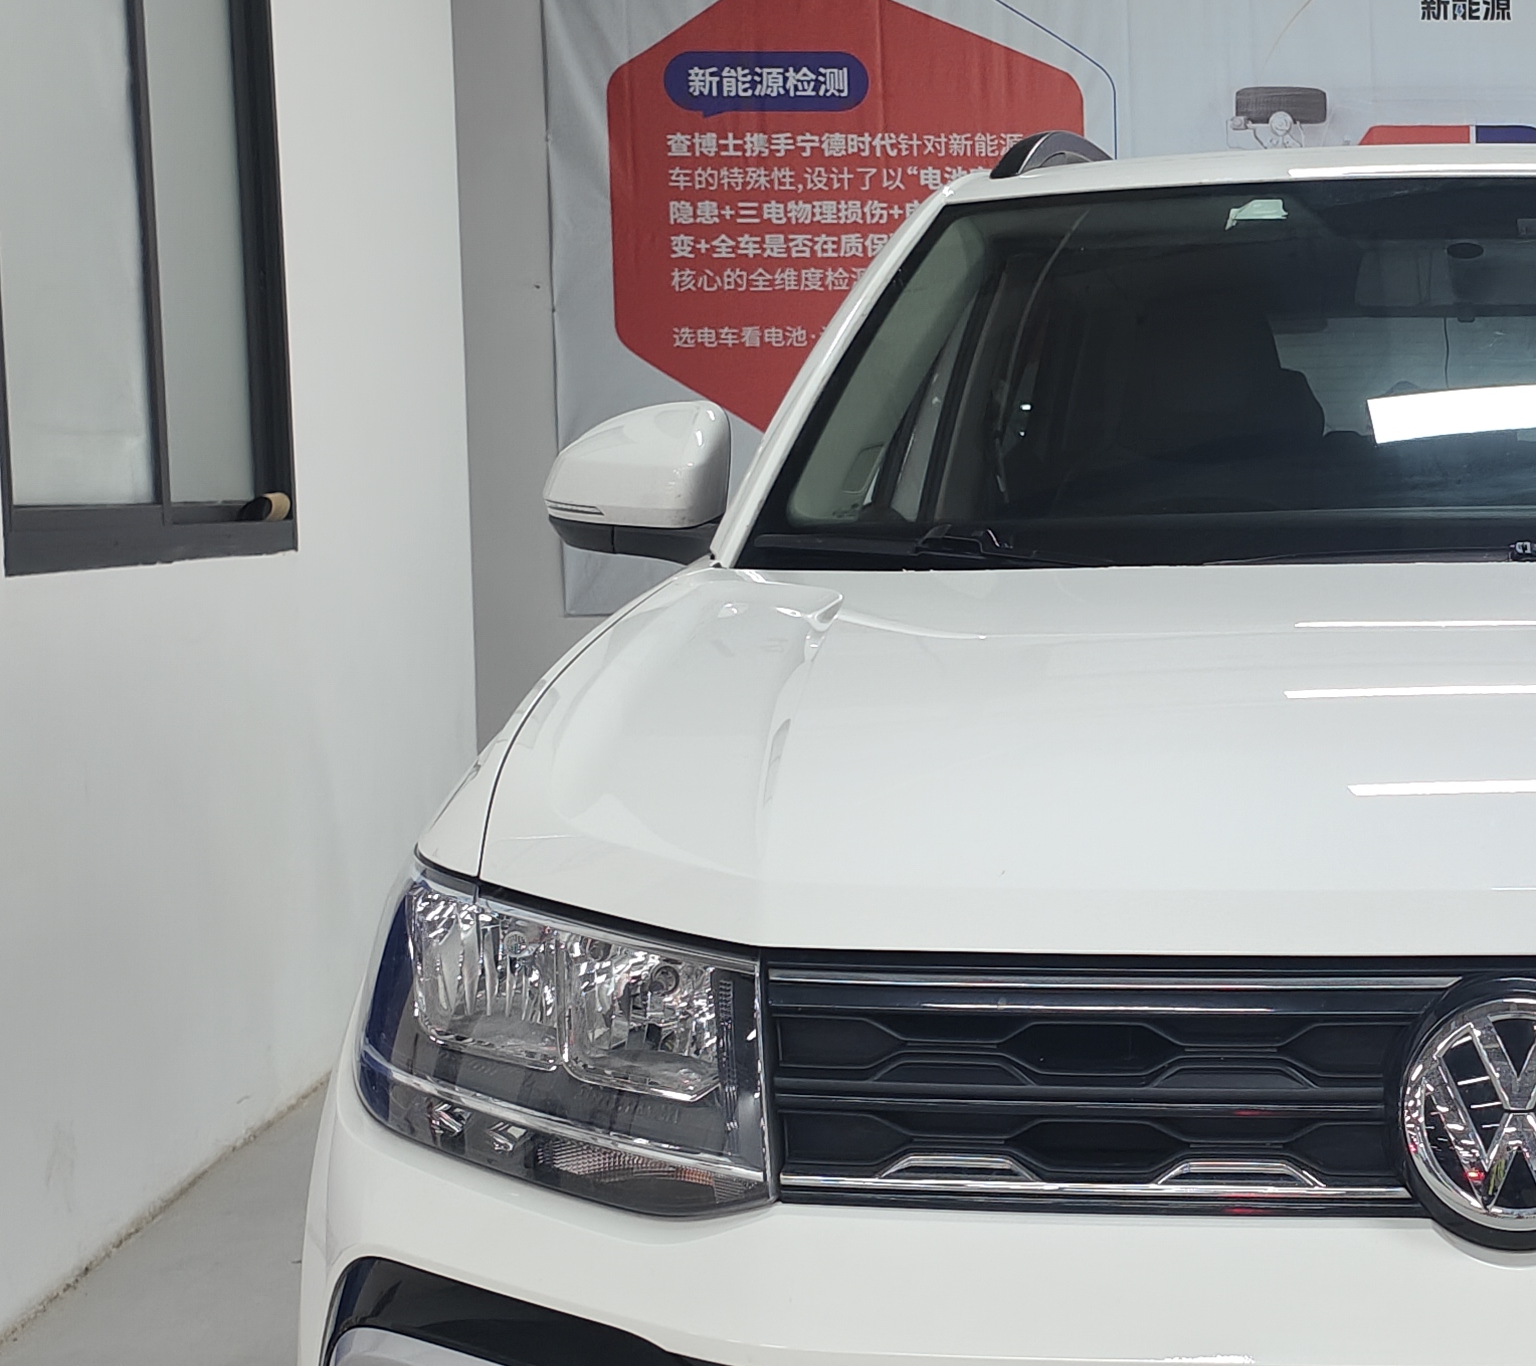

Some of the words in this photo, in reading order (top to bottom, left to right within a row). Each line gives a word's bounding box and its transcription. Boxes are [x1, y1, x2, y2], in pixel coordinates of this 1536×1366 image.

[687, 66, 849, 97] 新能源检测
